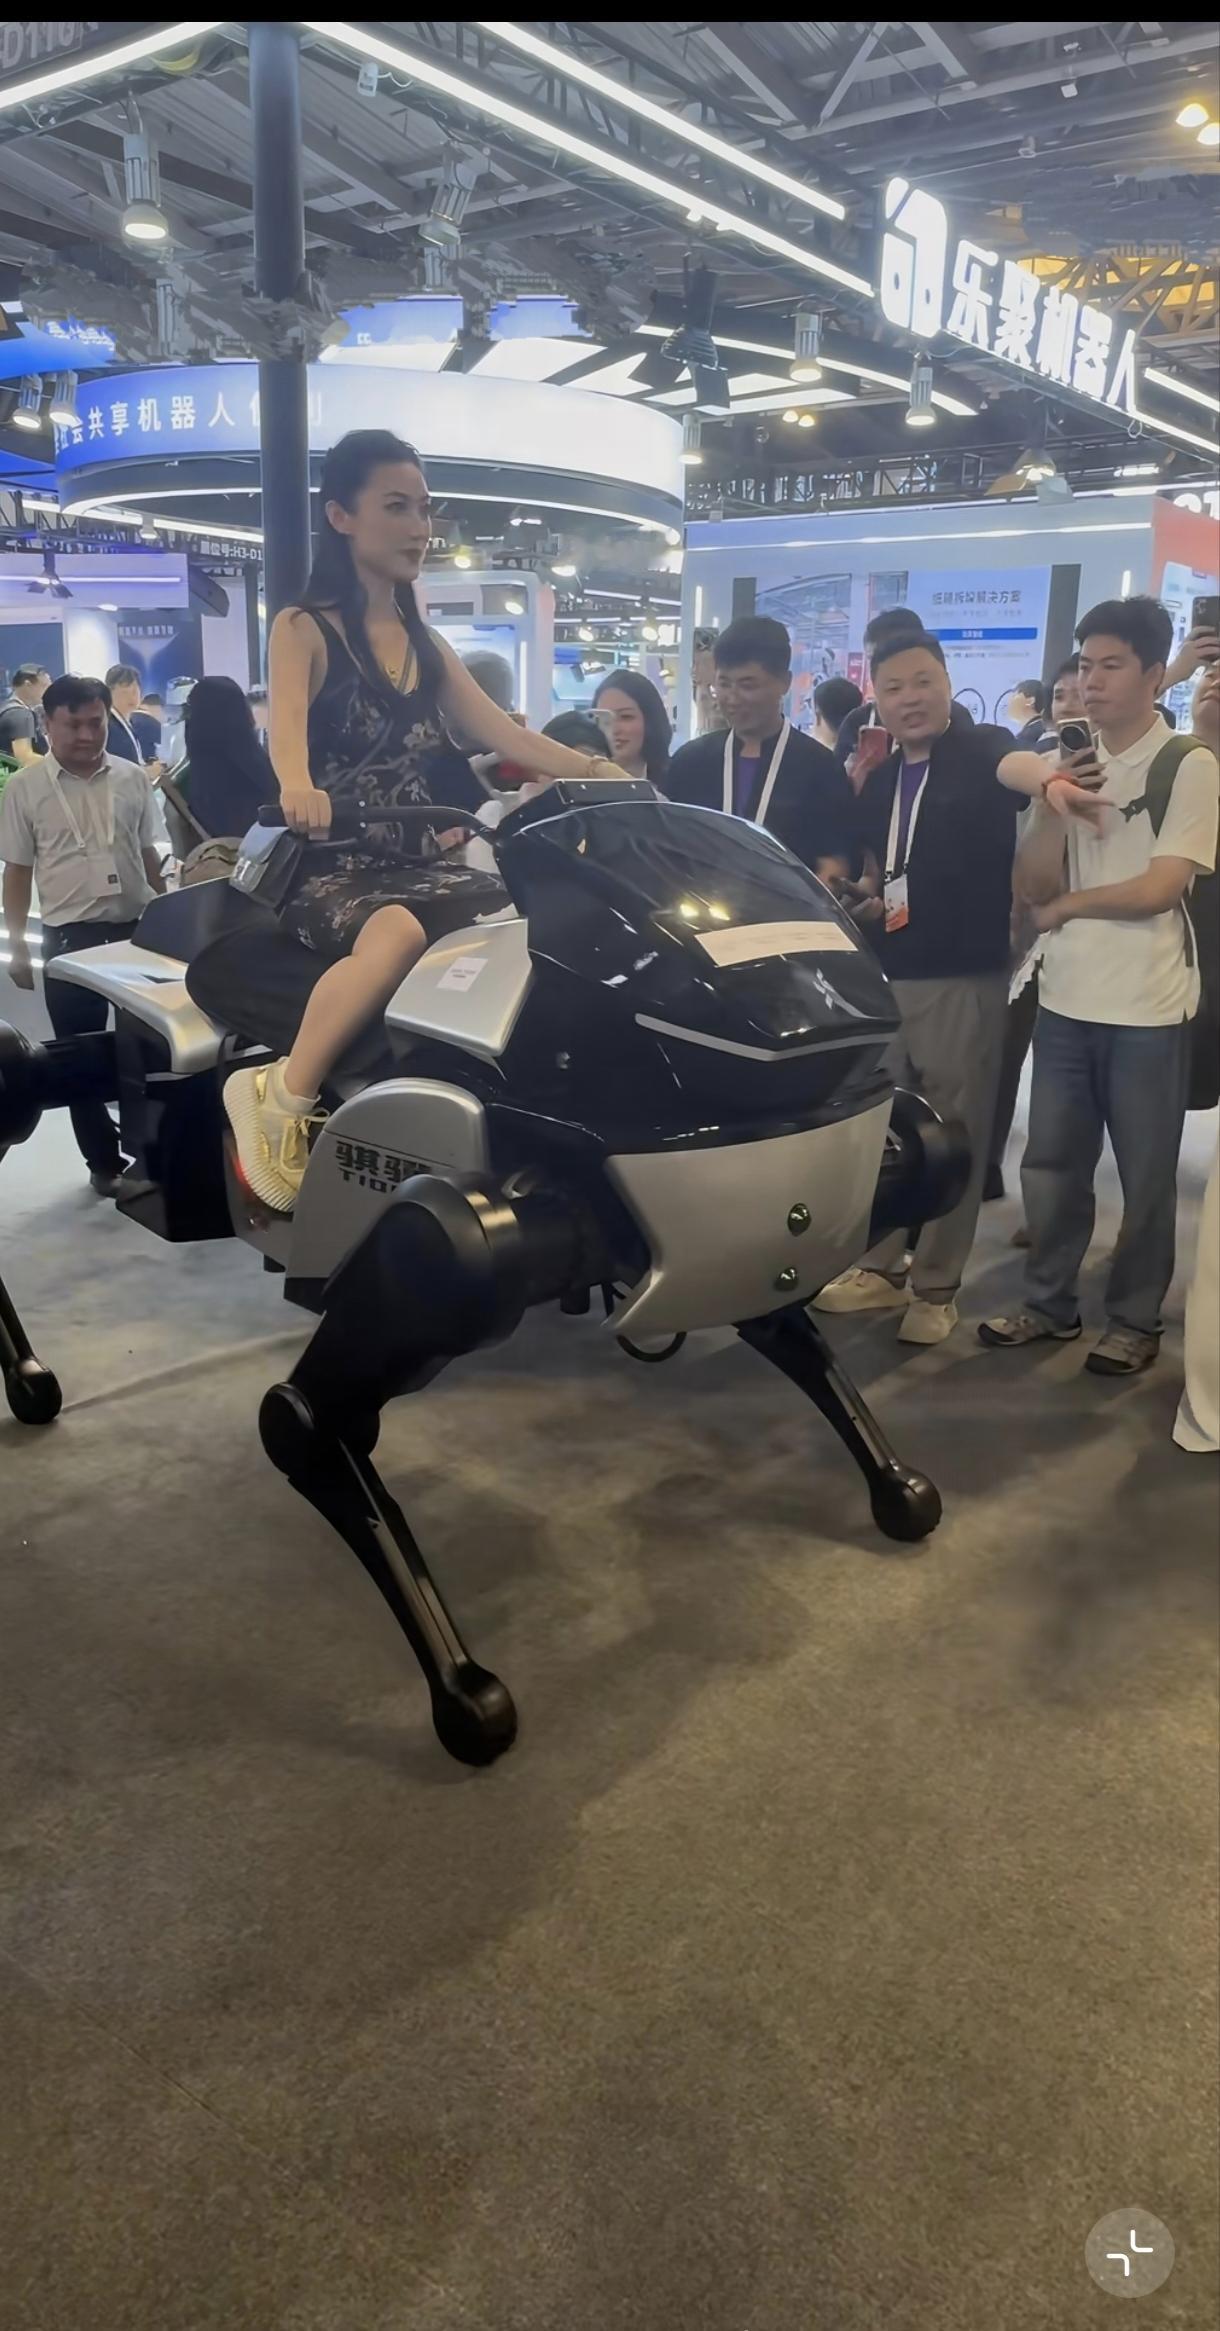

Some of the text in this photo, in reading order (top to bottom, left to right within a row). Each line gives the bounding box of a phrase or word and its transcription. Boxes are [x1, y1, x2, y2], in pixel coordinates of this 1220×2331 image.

[946, 239, 1137, 414] 乐聚机器人
